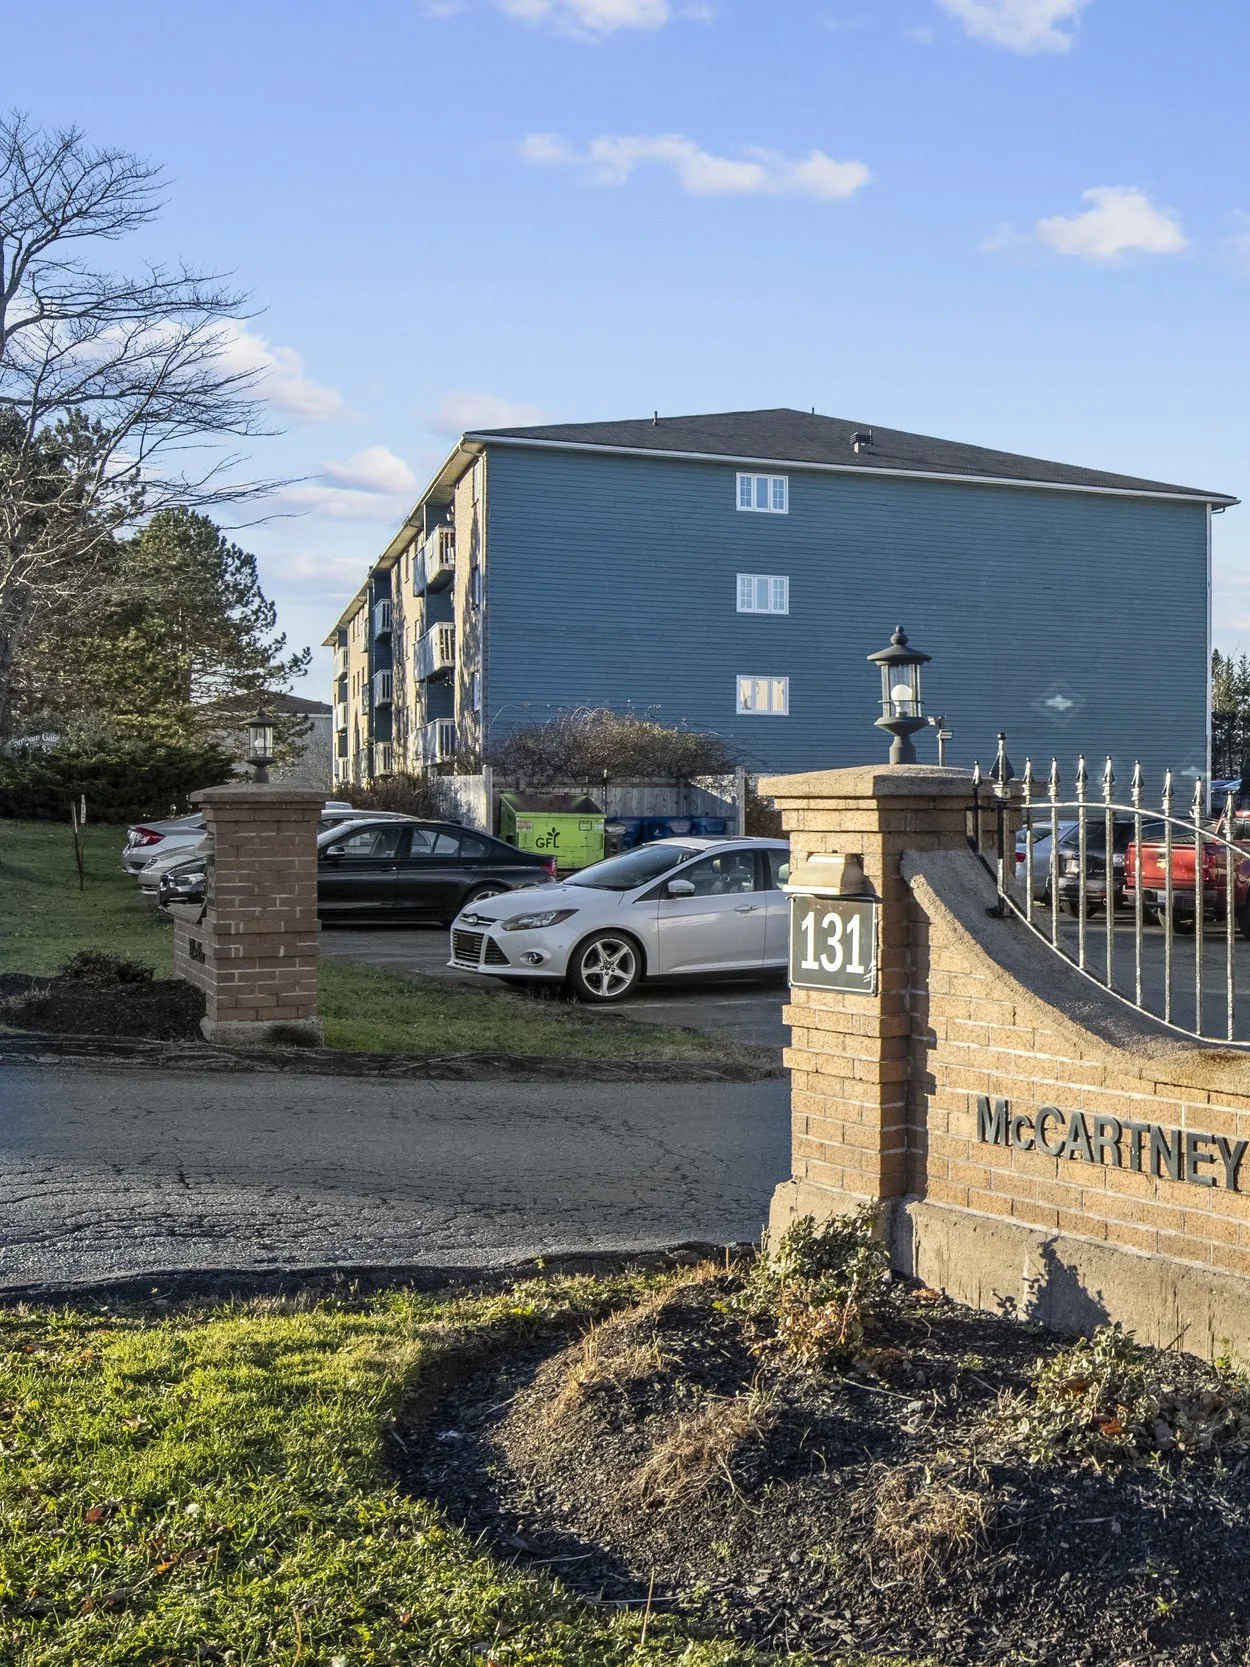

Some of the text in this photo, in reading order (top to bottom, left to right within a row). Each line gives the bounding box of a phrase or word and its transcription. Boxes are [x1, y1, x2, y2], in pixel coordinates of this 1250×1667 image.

[535, 829, 560, 848] GFL
[801, 911, 865, 974] 131
[976, 1096, 1249, 1193] McCARTNEY
